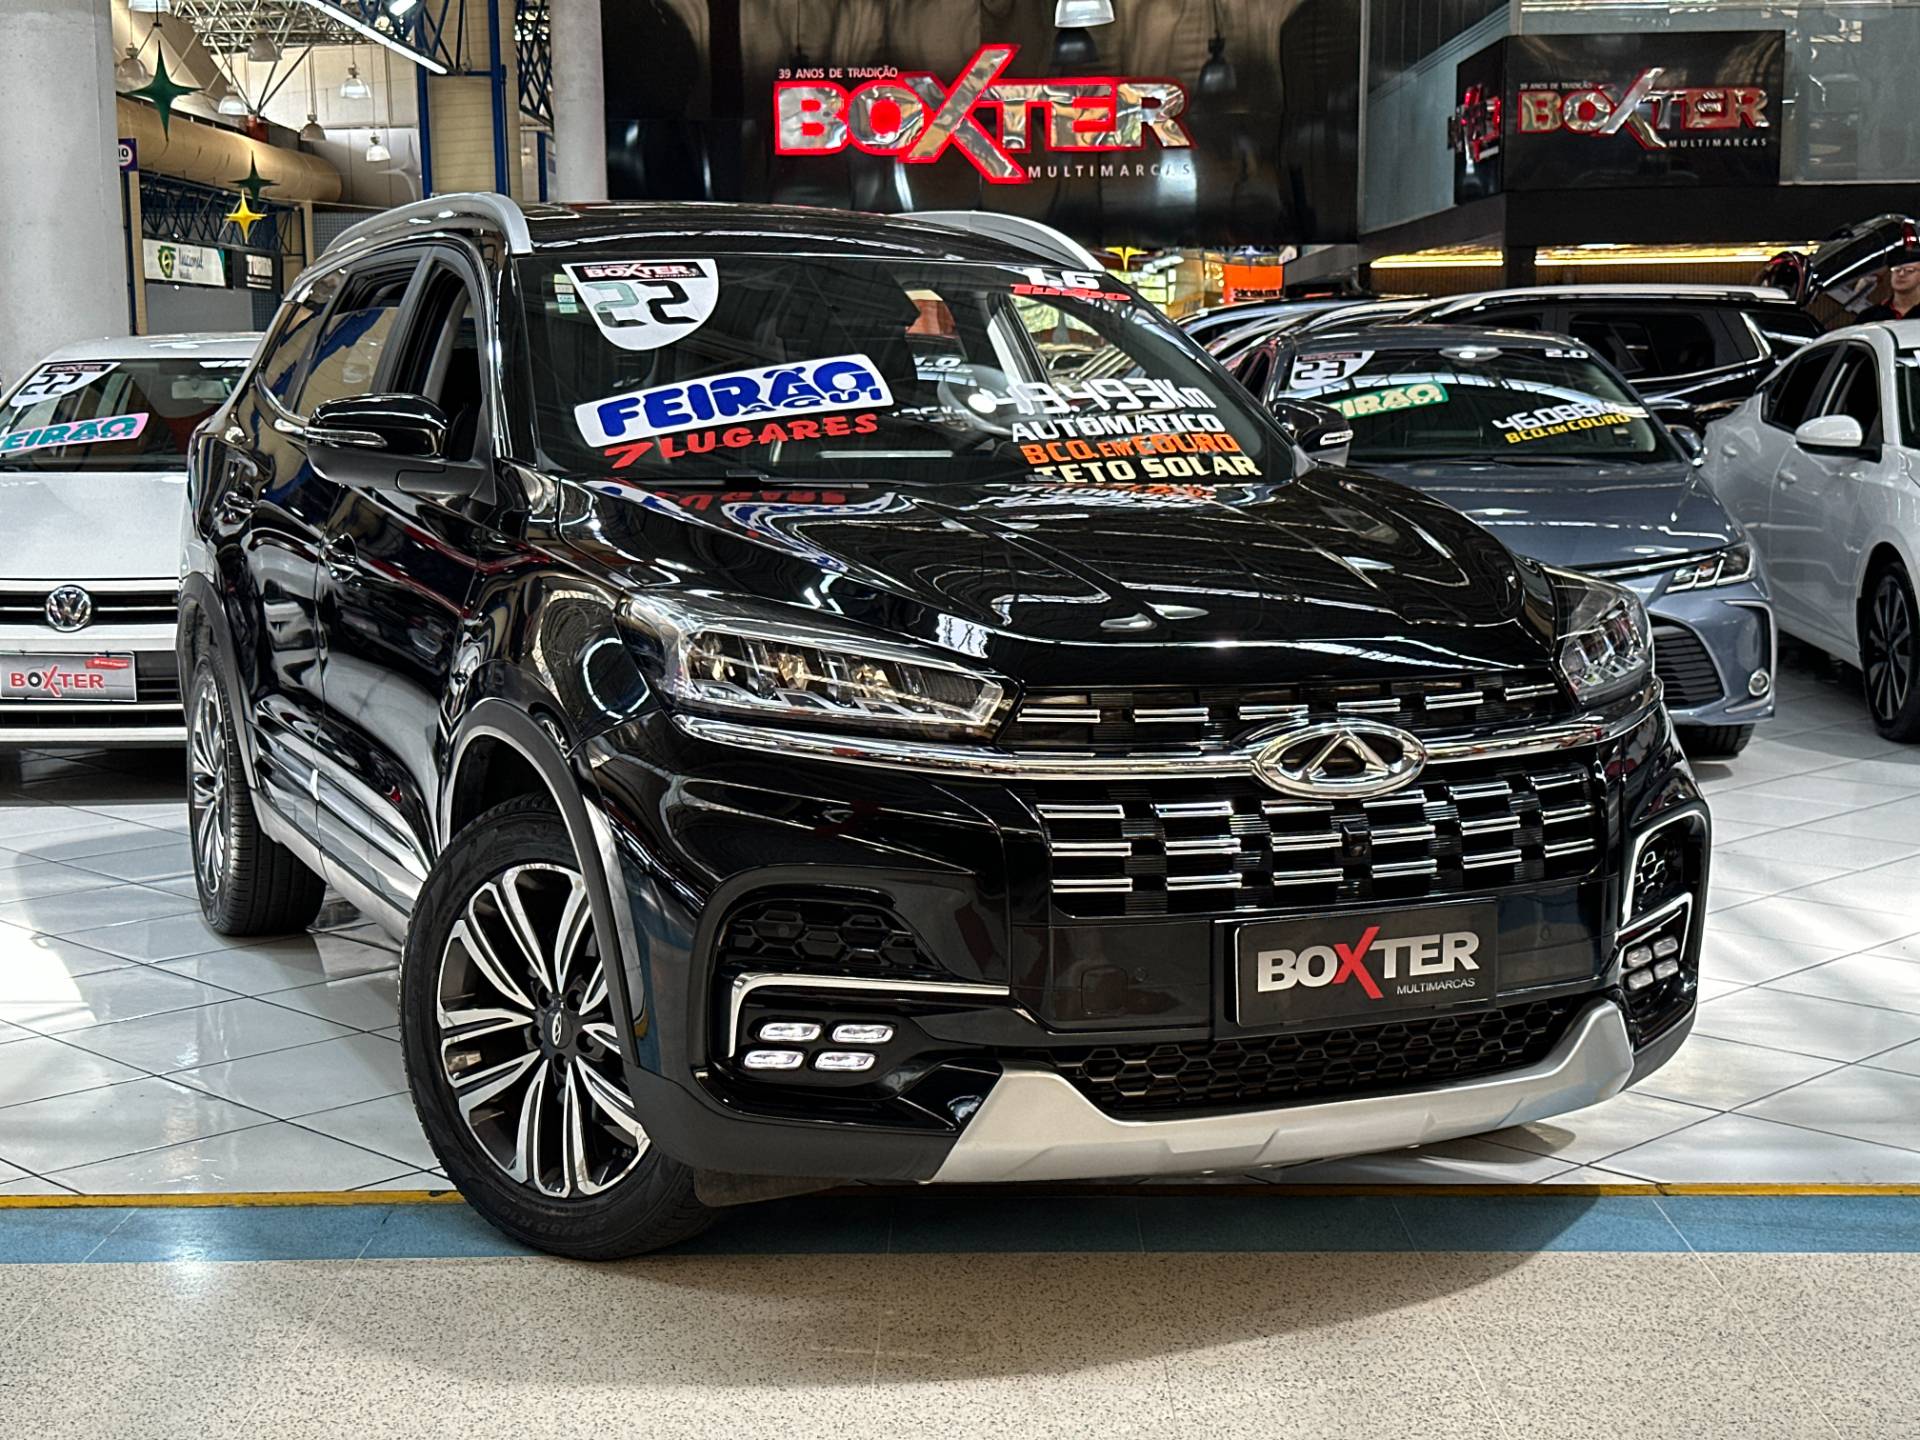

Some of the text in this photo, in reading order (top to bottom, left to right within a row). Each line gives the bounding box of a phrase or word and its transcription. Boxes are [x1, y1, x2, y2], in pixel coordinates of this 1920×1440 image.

[777, 65, 898, 80] 39 ANOS DE TRADIÇÃO
[773, 43, 1197, 185] BOXTER
[1517, 67, 1770, 151] BOXTER
[1669, 138, 1768, 149] MULTIMARCAS
[1028, 163, 1192, 179] MULTIMARCAS
[583, 263, 691, 279] BOXTER
[583, 280, 699, 329] 22
[1545, 348, 1590, 359] 2.0
[1296, 361, 1346, 380] 23
[18, 373, 84, 396] 22
[597, 361, 876, 437] FEIRÃO
[1328, 383, 1442, 417] IRÃO
[0, 417, 138, 449] EIRÃO
[604, 442, 654, 469] 7
[659, 413, 878, 459] LUGARES
[1132, 433, 1241, 455] COURO
[1034, 456, 1263, 483] TETO SOLAR
[10, 665, 105, 697] BOXTER
[1257, 926, 1480, 999] BOXTER
[1397, 977, 1476, 995] MULTIMARCAS
